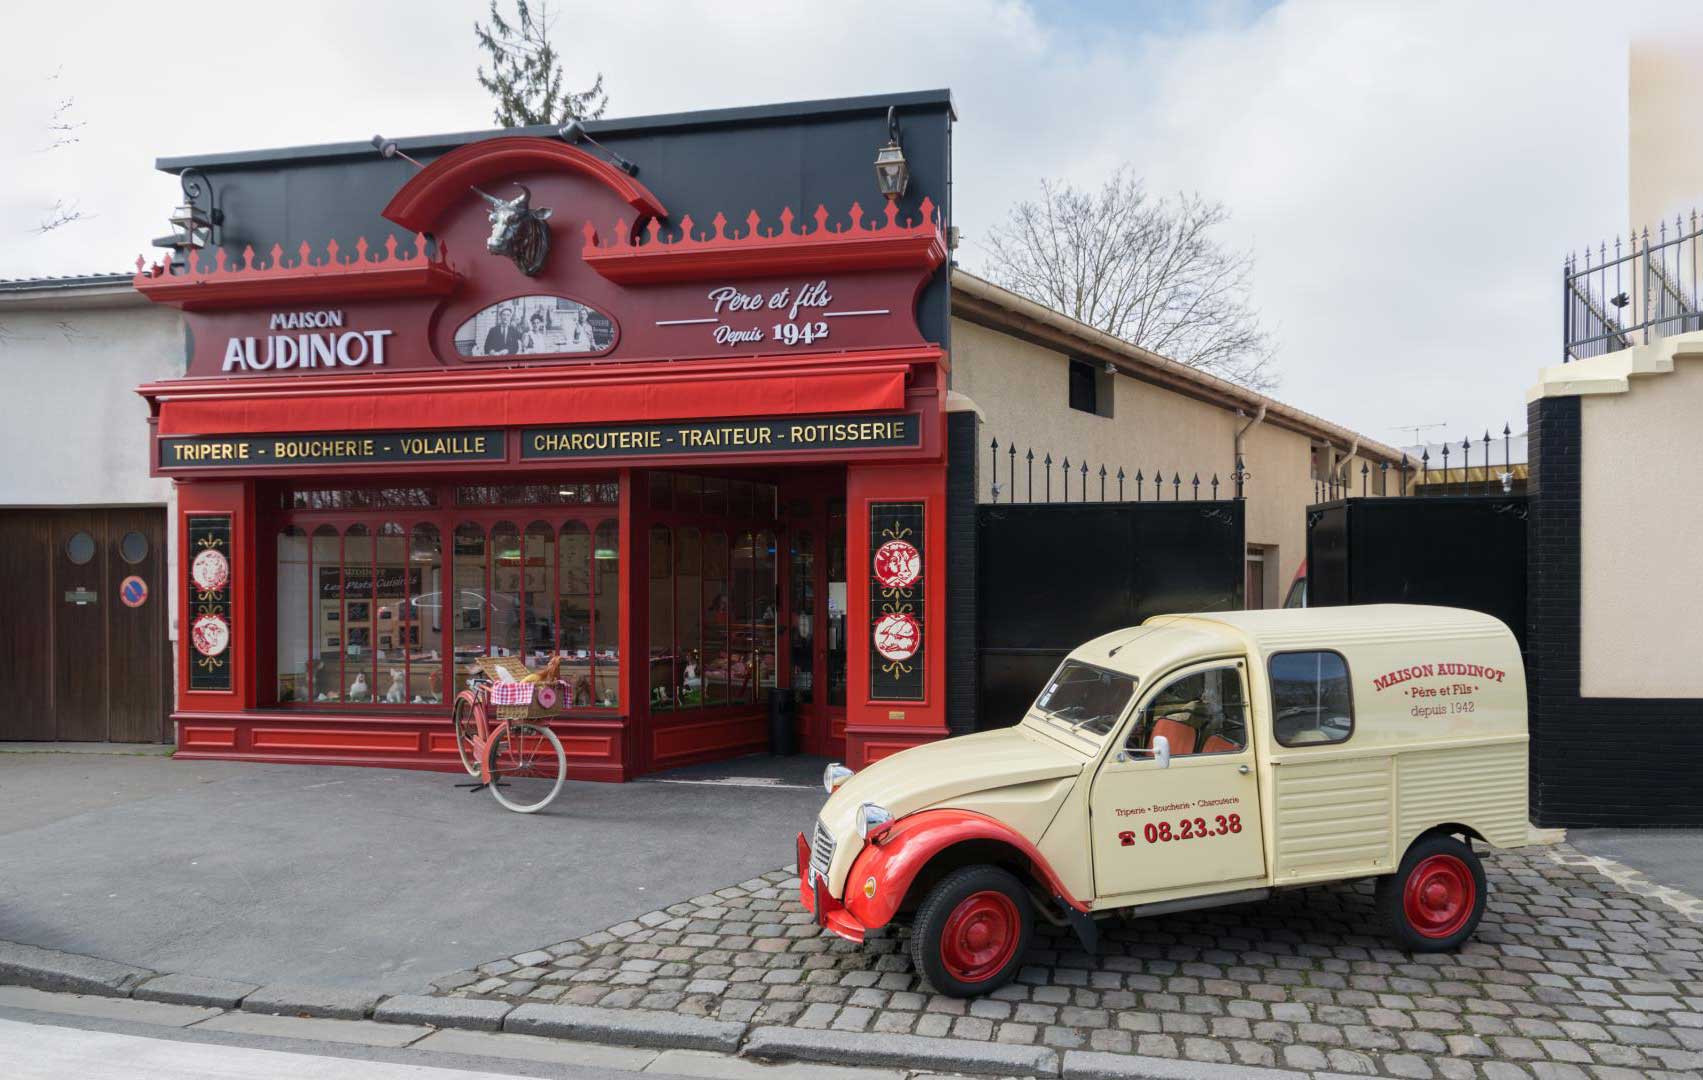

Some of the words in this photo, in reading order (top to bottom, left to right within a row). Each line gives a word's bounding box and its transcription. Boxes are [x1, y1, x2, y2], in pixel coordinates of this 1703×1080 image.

[708, 286, 764, 312] Père
[768, 286, 790, 309] et
[789, 279, 832, 320] fils
[269, 310, 343, 330] MAISON
[713, 324, 764, 346] Depuis
[772, 321, 829, 345] 1942
[222, 329, 393, 372] AUDINOT
[173, 443, 250, 461] TRIPERIE
[274, 439, 374, 458] BOUCHERIE
[400, 436, 486, 455] VOLAILLE
[533, 430, 662, 451] CHARCUTERIE
[678, 427, 772, 447] TRAITEUR
[790, 422, 905, 443] ROTISSERIE
[1373, 664, 1434, 692] MAISON
[1437, 663, 1506, 683] AUDINOT
[1411, 686, 1437, 698] Père
[1439, 685, 1451, 696] et
[1452, 683, 1473, 696] Fils
[1411, 703, 1447, 718] depuis
[1449, 701, 1475, 714] 1942
[1115, 807, 1146, 817] Triperie
[1153, 802, 1191, 813] Boucherie
[1197, 797, 1240, 808] Charcuterie
[1143, 813, 1243, 844] 08.23.38
